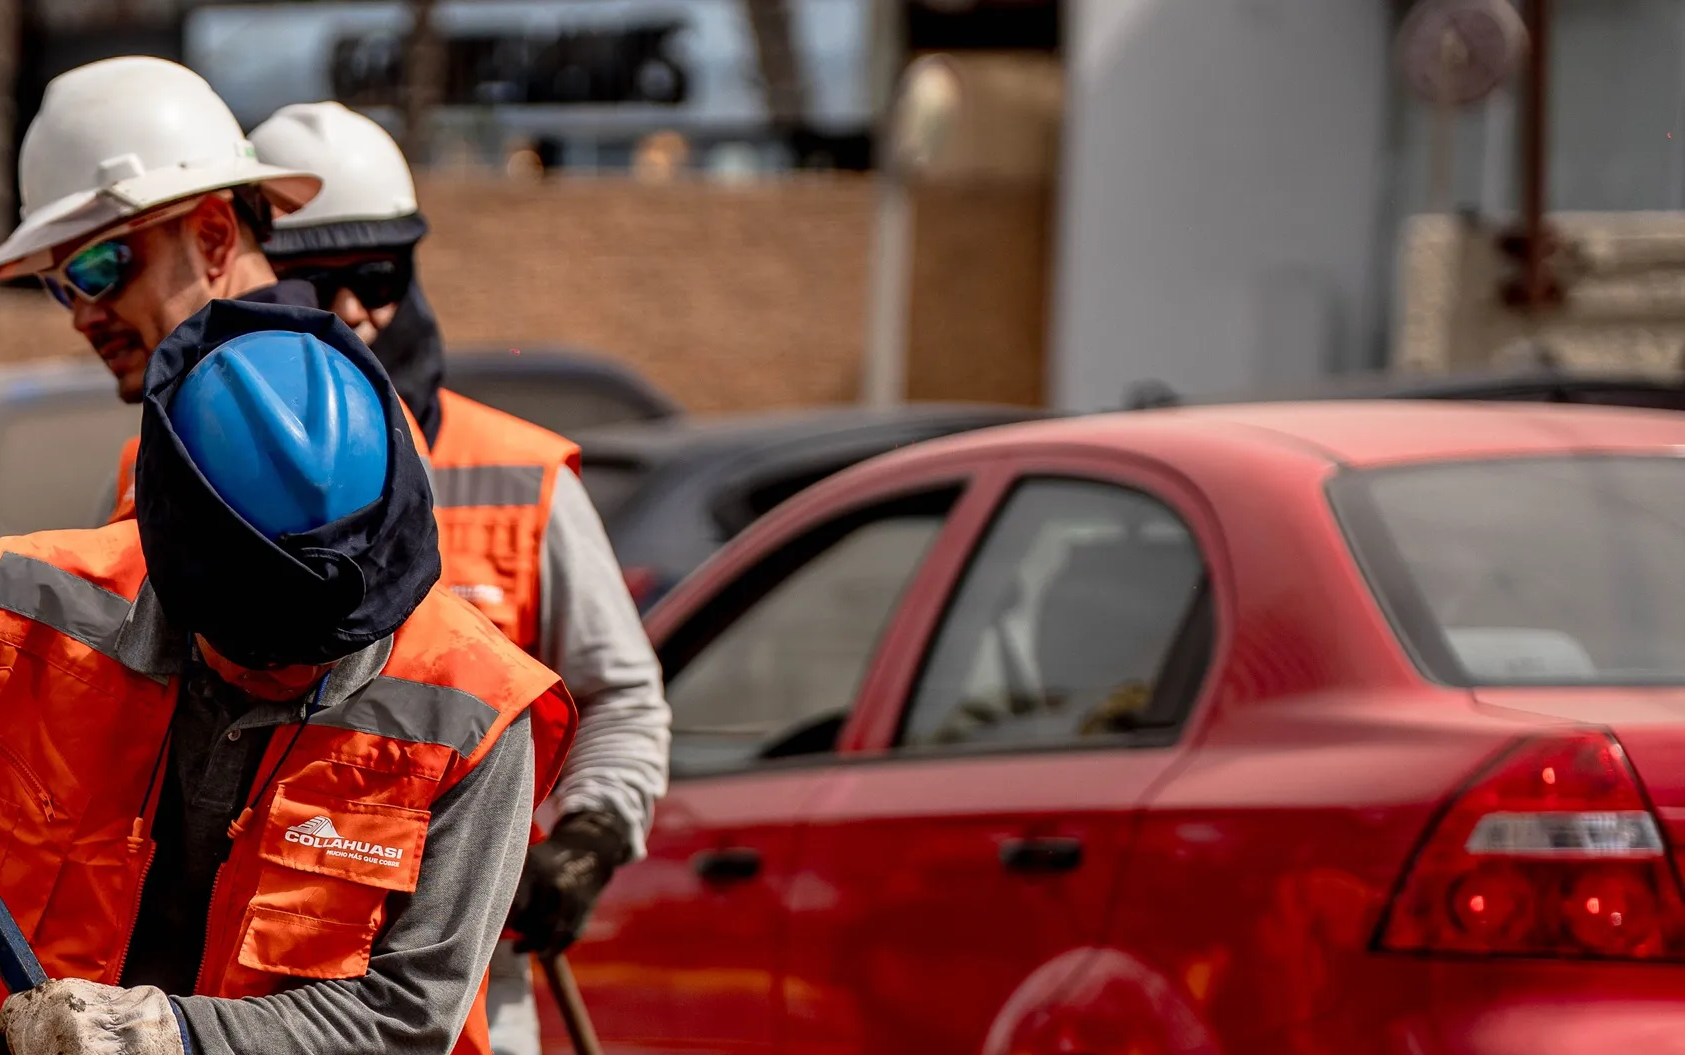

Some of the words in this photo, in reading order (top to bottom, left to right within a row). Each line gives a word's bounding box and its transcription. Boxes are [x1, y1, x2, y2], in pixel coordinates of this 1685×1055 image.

[284, 830, 404, 859] COLLAHUASI
[326, 849, 348, 858] MUCHO
[348, 851, 363, 861] MÁS
[363, 855, 378, 864] QUE
[378, 858, 400, 868] COBRE
